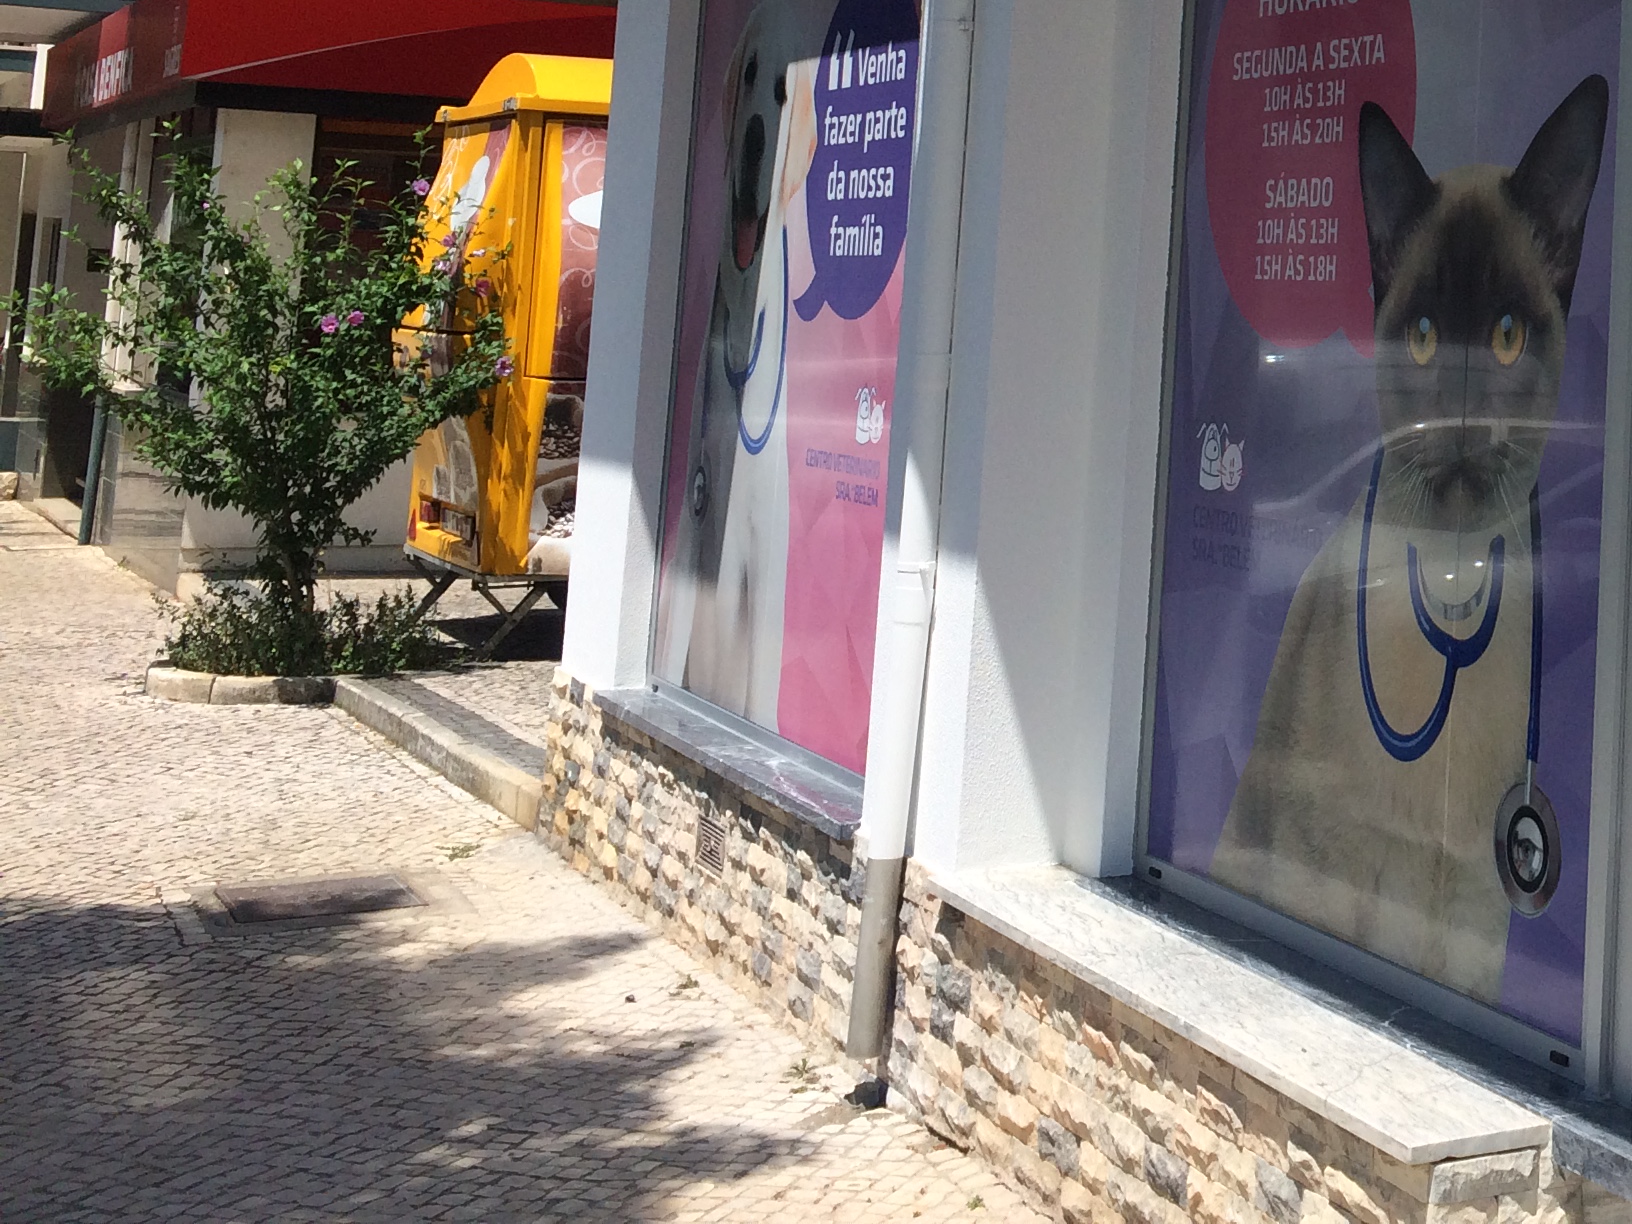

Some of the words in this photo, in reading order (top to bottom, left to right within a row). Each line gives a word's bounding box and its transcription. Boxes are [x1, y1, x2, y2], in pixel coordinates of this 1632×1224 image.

[1233, 45, 1308, 81] SEGUNDA
[1312, 43, 1325, 72] A
[1329, 34, 1386, 70] SEXTA
[1263, 85, 1290, 112] 10H
[1293, 78, 1313, 109] ÀS
[1316, 79, 1346, 107] 13H
[823, 105, 862, 146] fazer
[863, 100, 907, 154] parte
[1261, 120, 1289, 148] 15H
[1291, 113, 1311, 145] ÀS
[1314, 116, 1344, 143] 20H
[827, 160, 846, 201] da
[848, 165, 894, 200] nossa
[1264, 171, 1334, 209] SÁBADO
[829, 213, 884, 257] família
[1256, 219, 1284, 244] 10H
[1286, 213, 1306, 244] ÀS
[1309, 218, 1339, 244] 13H
[1254, 255, 1281, 281] 15H
[1284, 249, 1304, 281] ÀS
[1307, 255, 1337, 281] 18H
